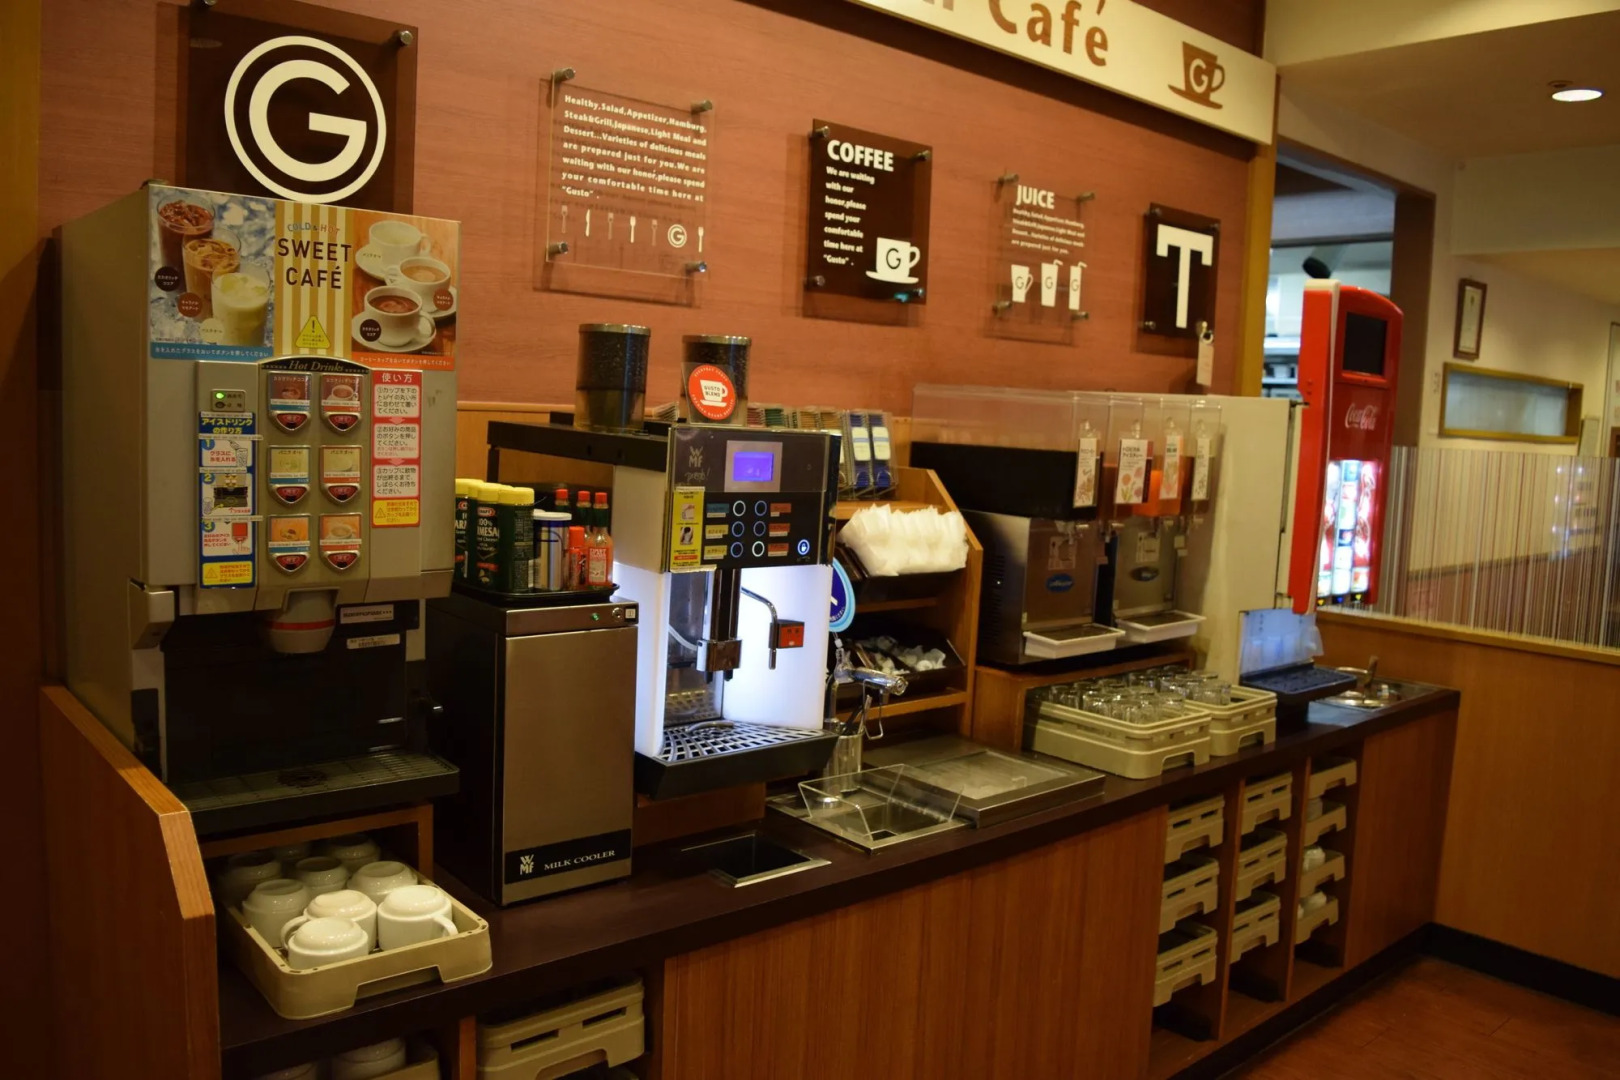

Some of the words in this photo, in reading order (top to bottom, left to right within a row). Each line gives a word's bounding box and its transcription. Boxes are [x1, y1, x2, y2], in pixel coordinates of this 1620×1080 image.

[249, 59, 367, 182] G
[673, 132, 691, 145] Meal
[692, 136, 707, 147] and
[563, 141, 578, 151] are
[581, 143, 622, 159] prepared
[624, 150, 641, 162] just
[643, 154, 656, 165] for
[659, 159, 690, 172] you.We
[692, 166, 705, 175] are
[639, 139, 649, 149] of
[649, 142, 683, 157] delicious
[684, 148, 706, 161] meals
[827, 139, 894, 172] COFFEE
[562, 157, 594, 170] waiting
[596, 162, 614, 173] with
[617, 166, 631, 176] our
[683, 176, 705, 188] spend
[826, 166, 838, 176] We
[838, 169, 850, 178] are
[850, 171, 875, 185] waiting
[561, 171, 584, 182] your
[587, 174, 646, 192] comfortable
[648, 185, 669, 197] time
[672, 189, 692, 200] here
[694, 194, 704, 202] at
[825, 181, 841, 191] with
[842, 185, 854, 194] our
[1015, 184, 1055, 210] JUICE
[824, 211, 845, 222] spend
[845, 215, 861, 225] your
[320, 224, 340, 234] HOT
[824, 225, 864, 239] comfortable
[278, 238, 352, 263] SWEET
[823, 239, 839, 250] time
[840, 242, 855, 252] here
[855, 245, 863, 253] at
[886, 248, 901, 270] G
[286, 265, 342, 289] CAFÉ
[1156, 223, 1213, 329] T
[289, 361, 309, 371] Hot
[311, 361, 344, 372] Drinks
[381, 373, 413, 383] 使い方
[201, 418, 253, 427] アイスドリンク
[212, 426, 243, 435] の作り方
[203, 474, 211, 482] 2
[544, 859, 571, 871] MILK
[573, 850, 616, 864] COOLER
